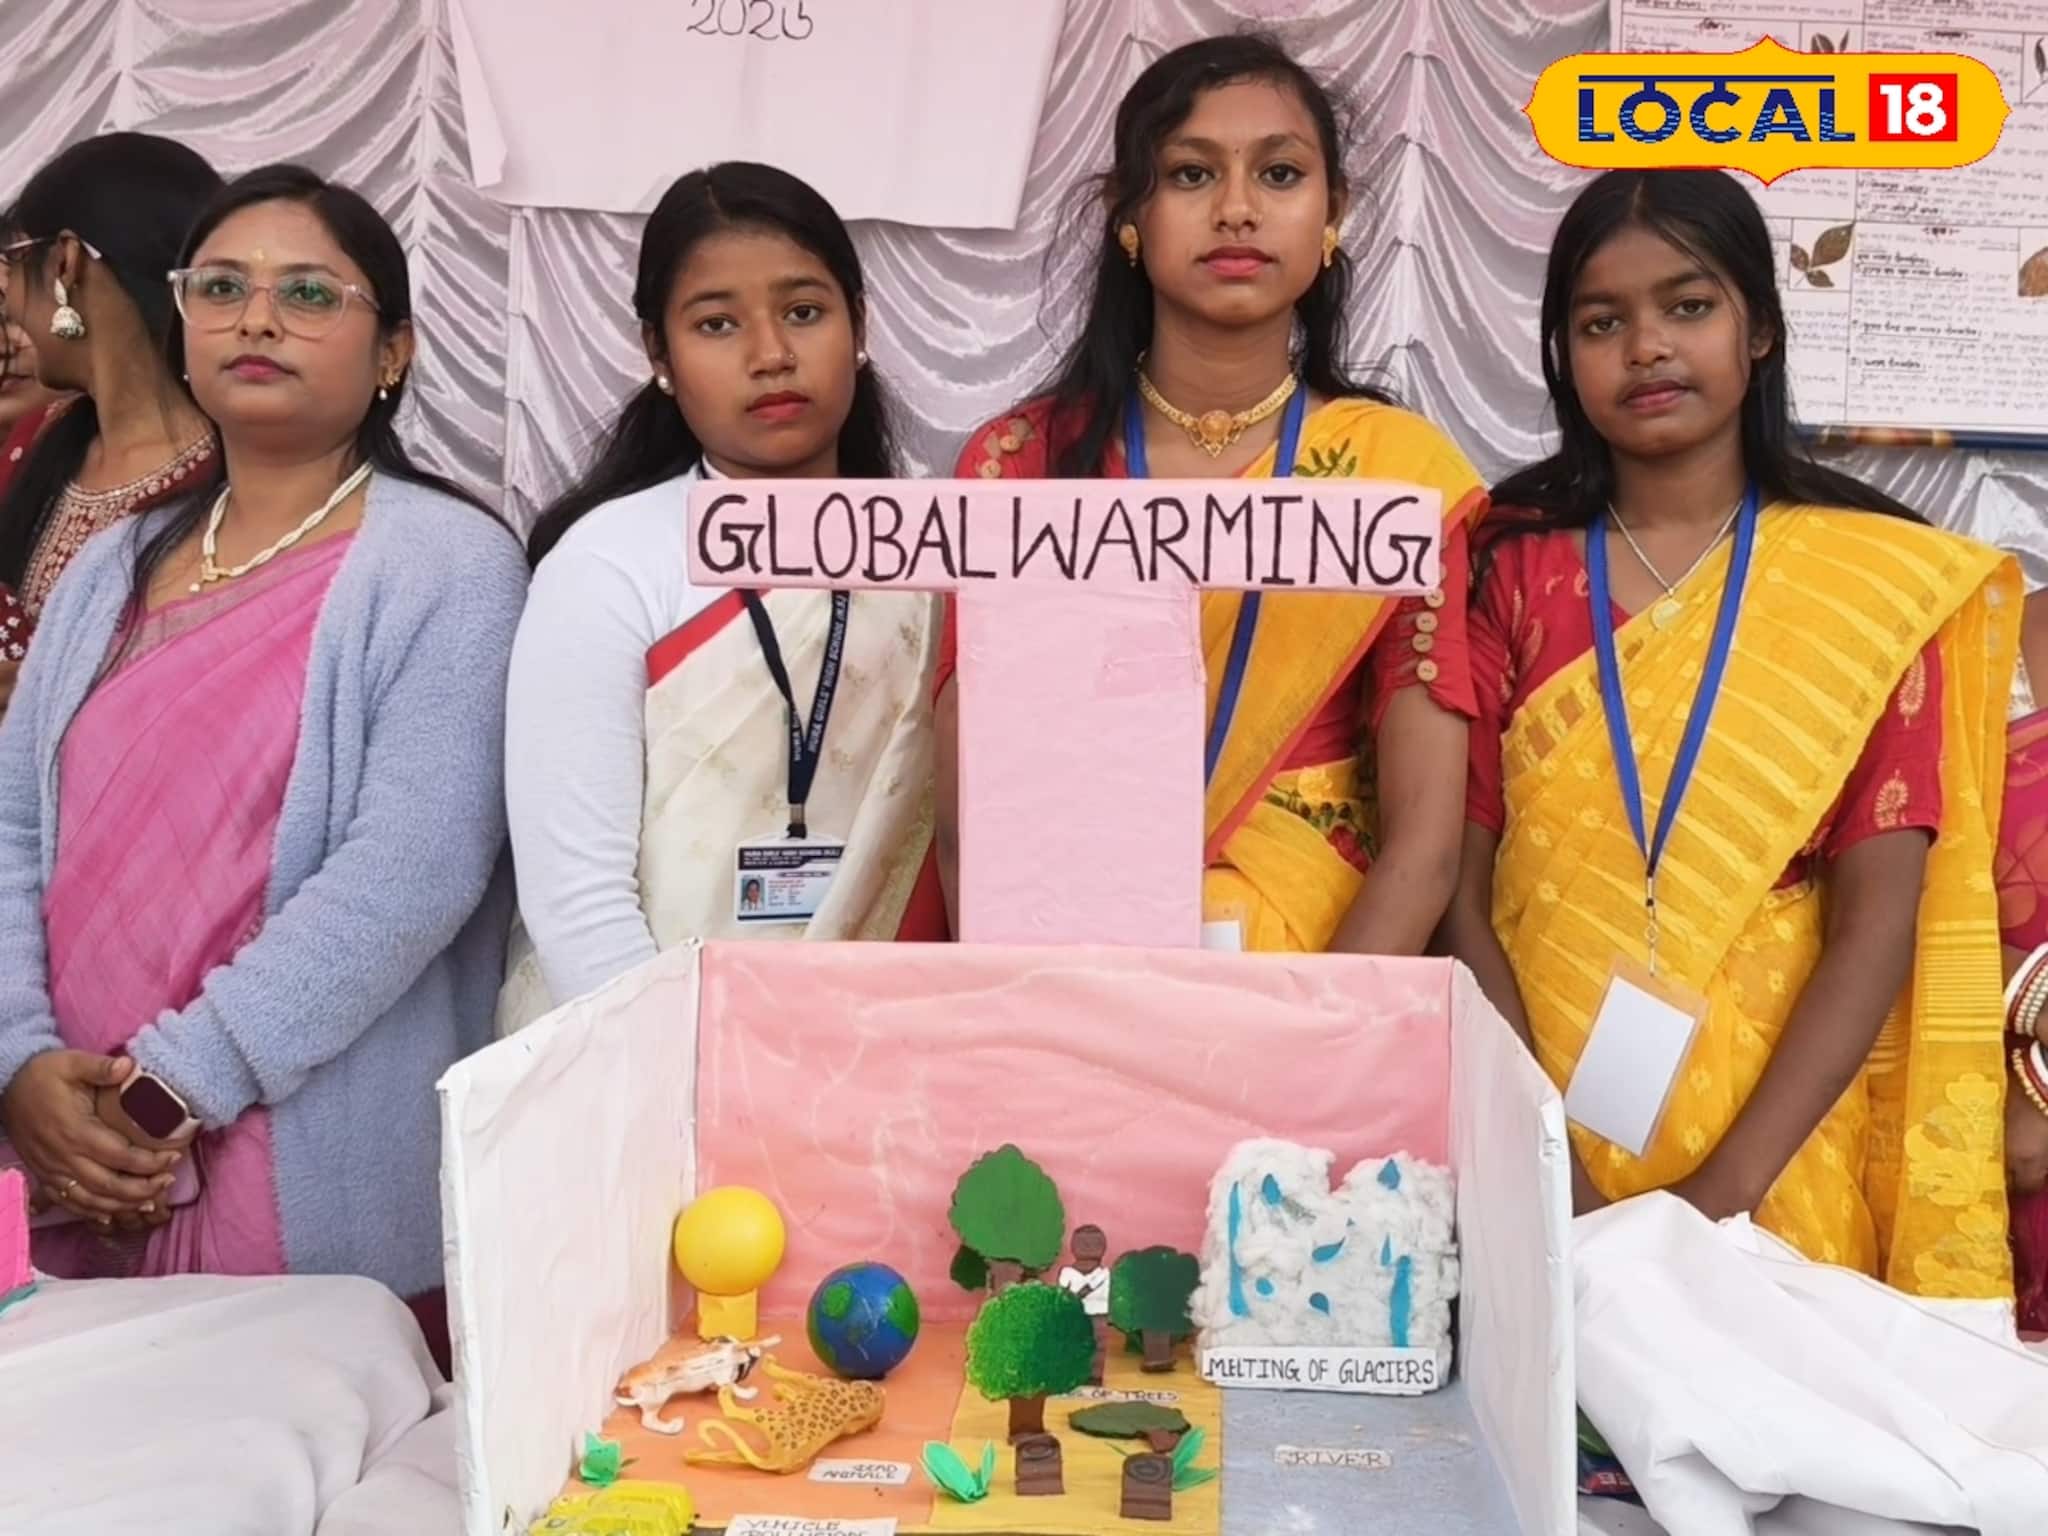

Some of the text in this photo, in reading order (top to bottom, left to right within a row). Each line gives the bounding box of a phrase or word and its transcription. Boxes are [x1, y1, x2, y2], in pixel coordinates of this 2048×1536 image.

[700, 491, 1433, 585] GLOBAL WARMING
[1204, 1357, 1435, 1385] MELTING OF GLACIERS
